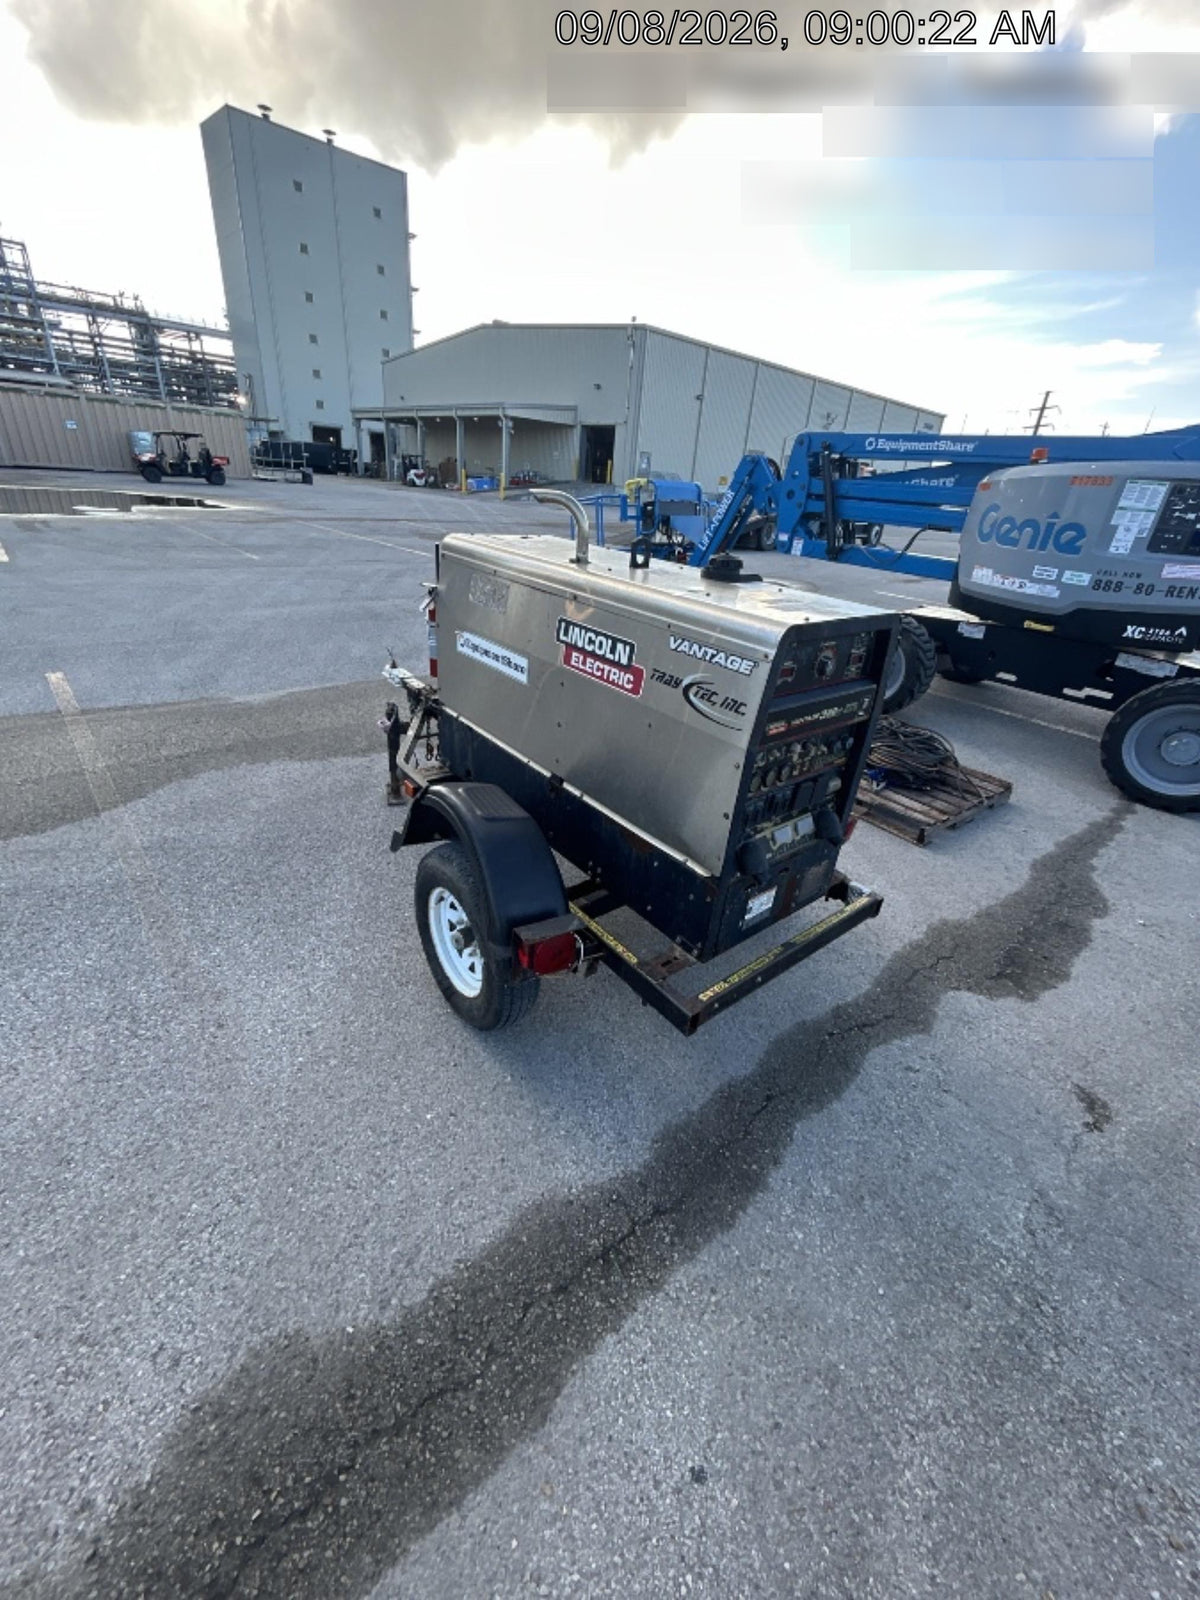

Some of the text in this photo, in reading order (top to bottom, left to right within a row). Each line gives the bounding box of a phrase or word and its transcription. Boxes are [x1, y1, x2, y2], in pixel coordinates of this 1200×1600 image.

[876, 439, 976, 452] EquipmentShare
[977, 502, 1087, 556] Genie
[1092, 579, 1200, 600] 888-80-REN
[559, 621, 631, 666] LINCOLN
[1122, 625, 1146, 639] XC
[570, 651, 634, 689] ELECTRIC
[668, 635, 755, 676] VANTAGE
